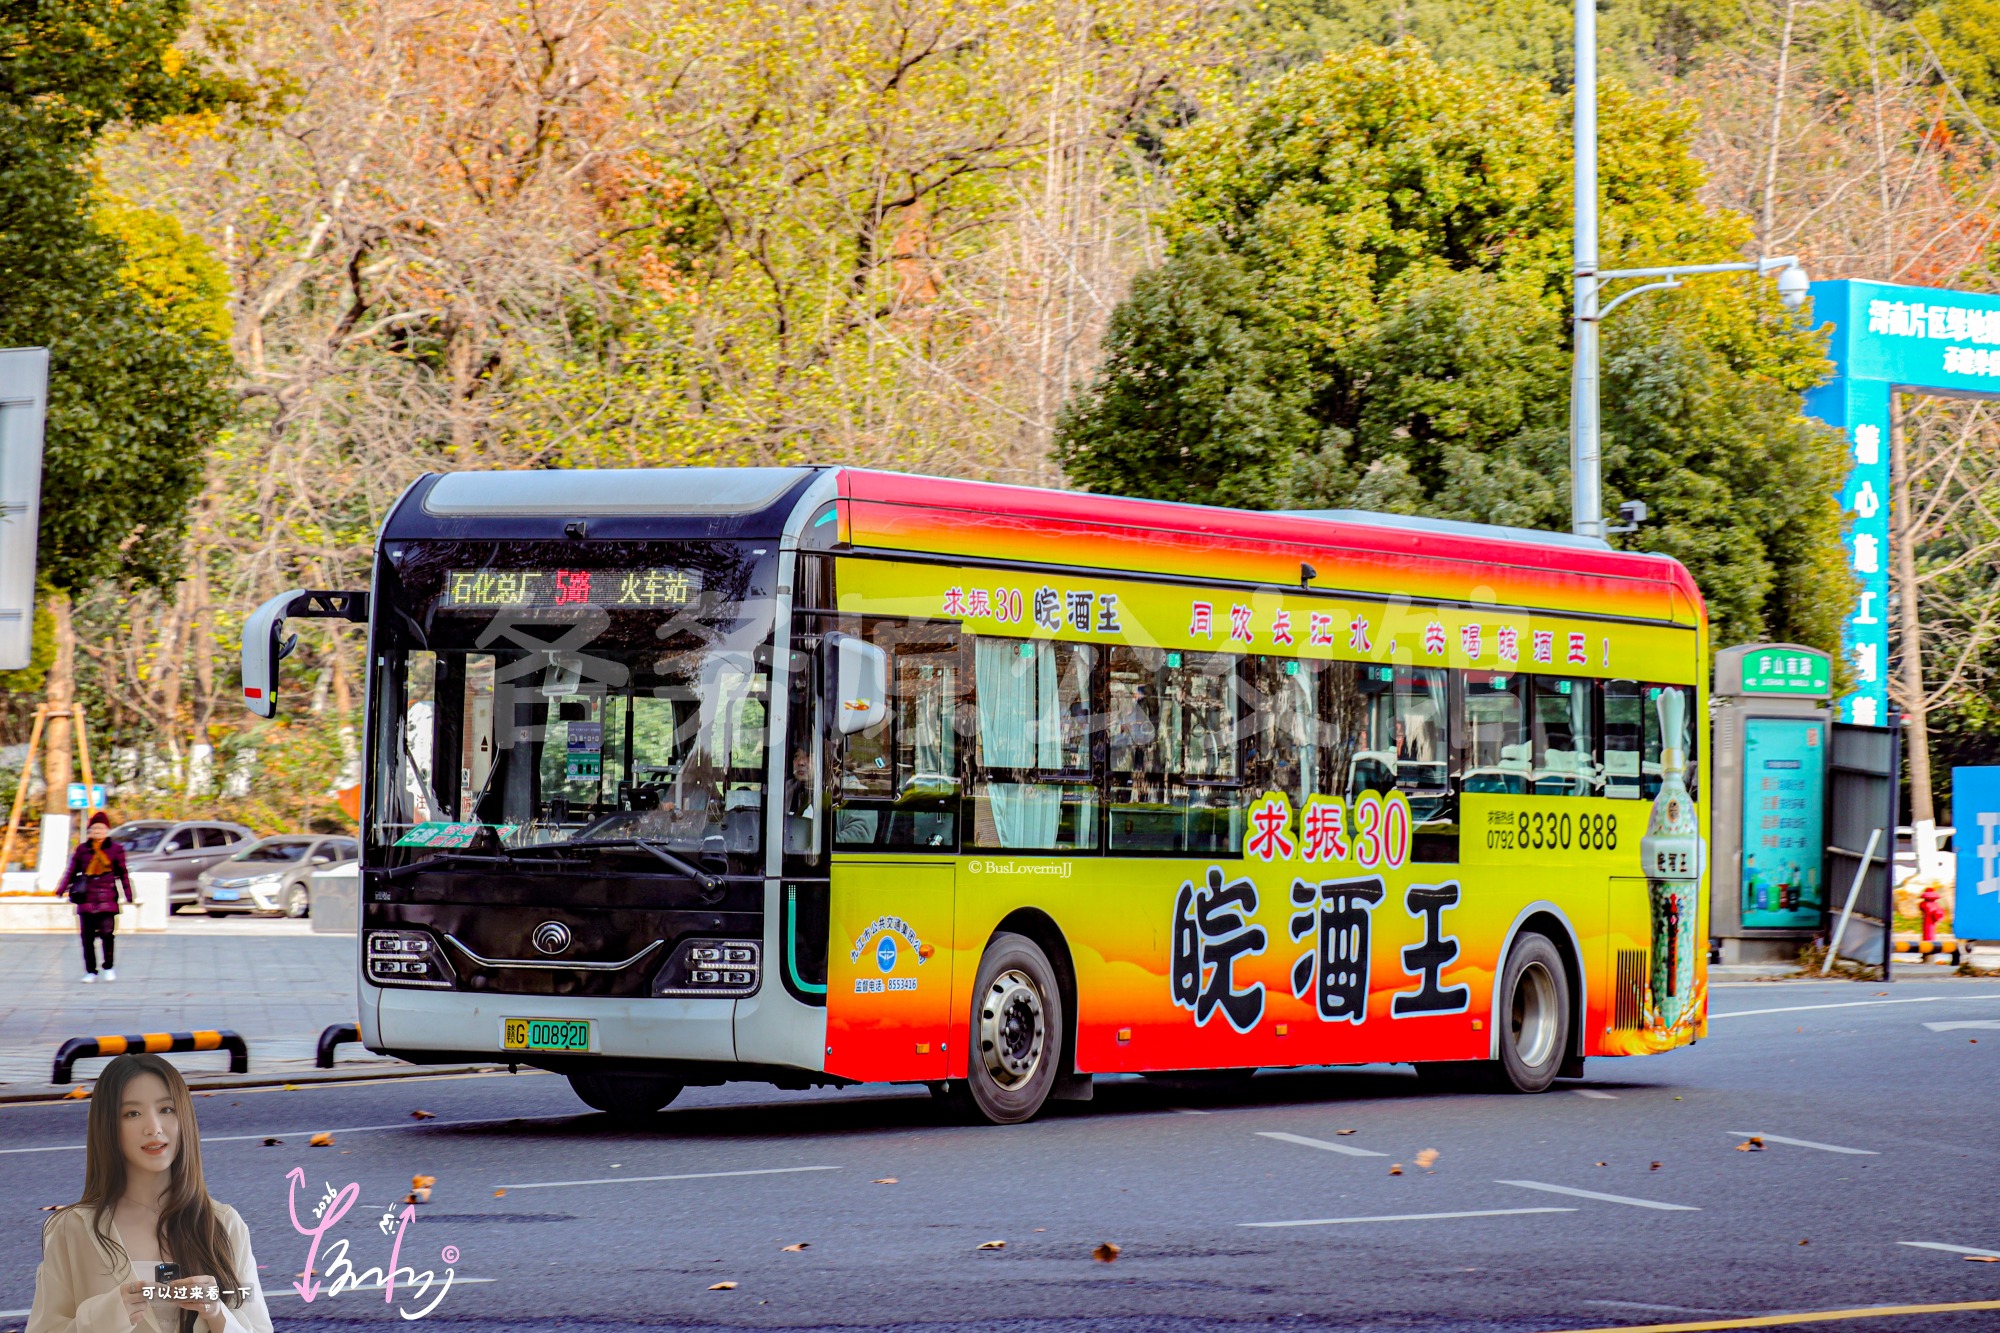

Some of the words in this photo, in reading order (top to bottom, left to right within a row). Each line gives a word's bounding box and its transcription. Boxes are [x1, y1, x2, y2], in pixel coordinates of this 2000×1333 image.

[452, 573, 542, 603] 石化总厂
[556, 570, 592, 606] 5路
[618, 570, 689, 605] 火车站
[943, 586, 1023, 624] 求振30
[1032, 585, 1121, 634] 皖酒王
[1246, 796, 1409, 872] 求振30
[1487, 829, 1514, 849] 0792
[1518, 811, 1571, 849] 8330
[1579, 813, 1617, 850] 888
[1171, 867, 1470, 1034] 皖酒王
[887, 978, 917, 990] 8553416
